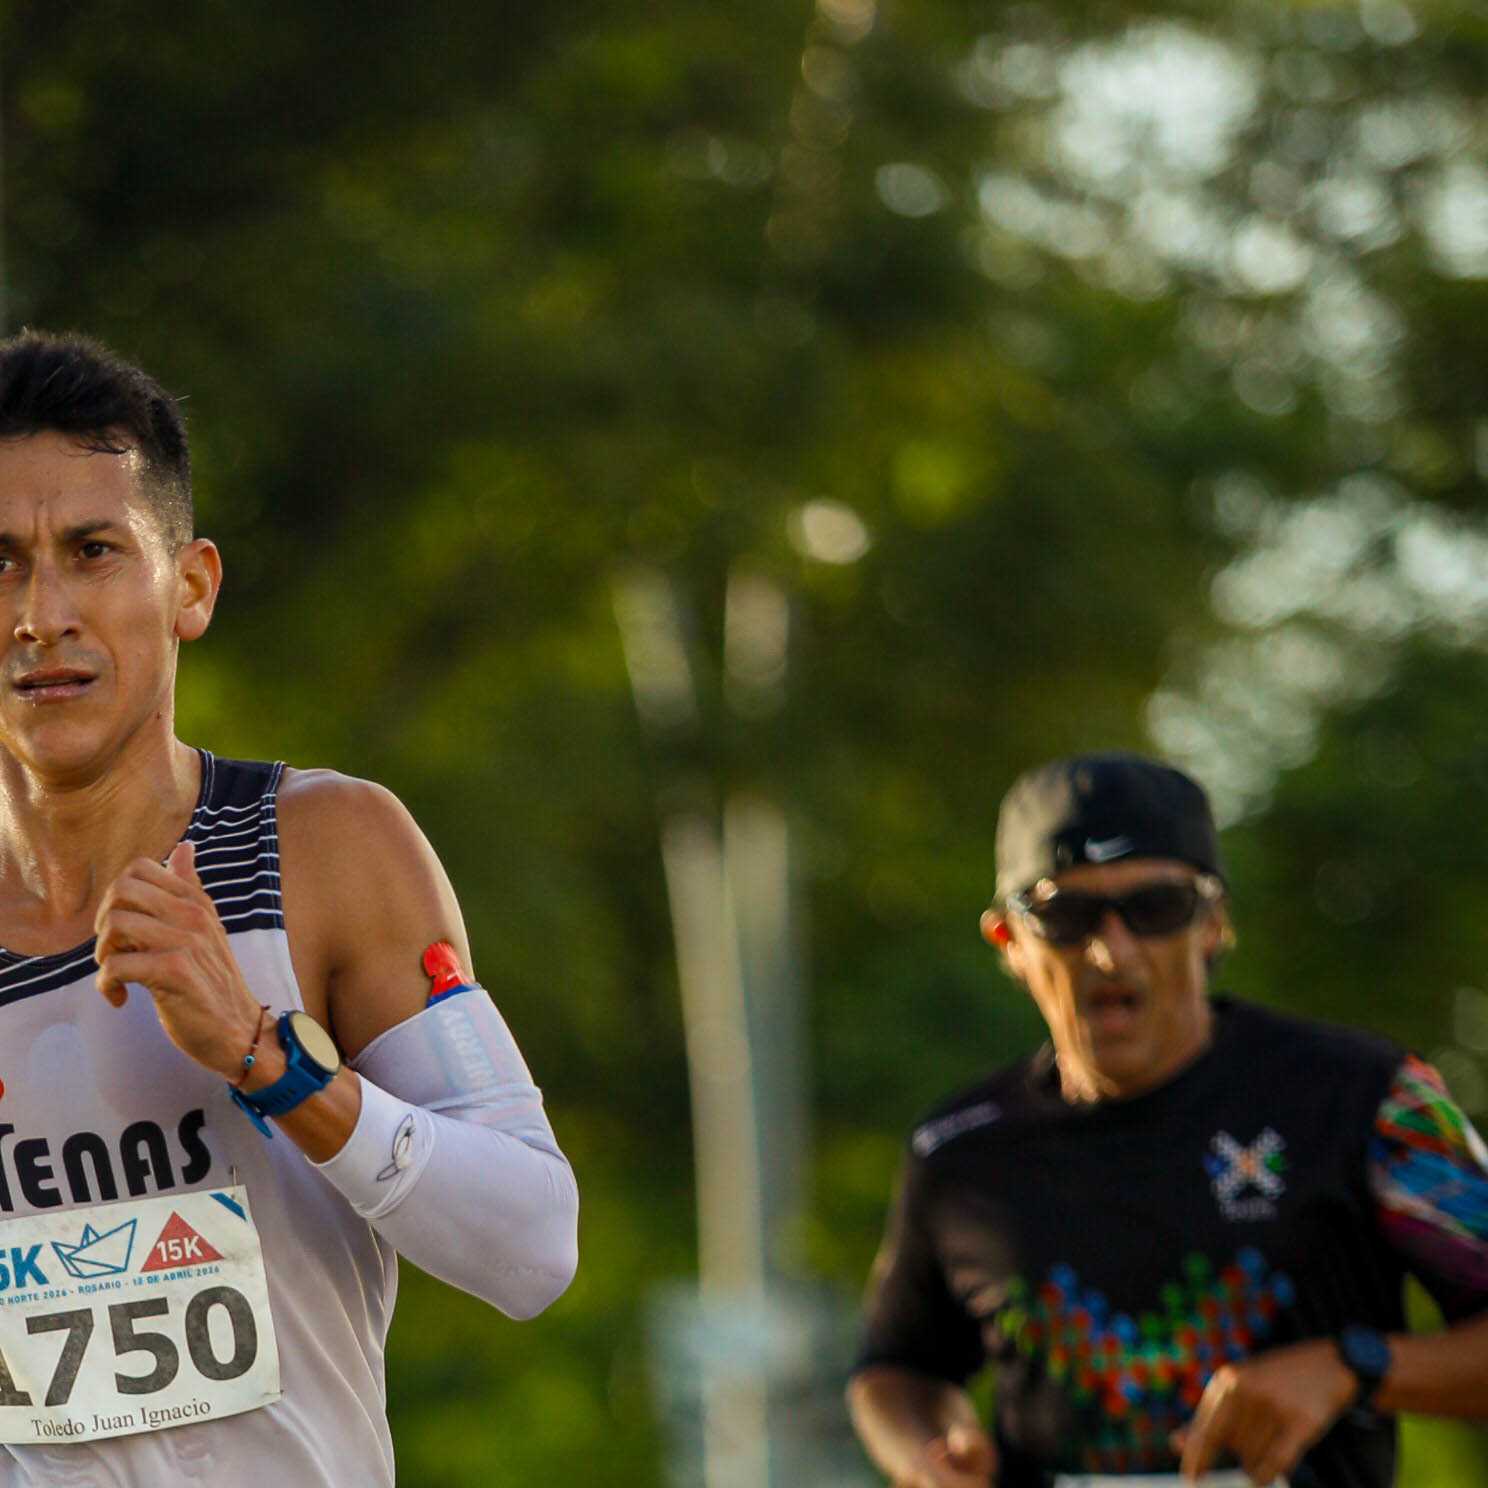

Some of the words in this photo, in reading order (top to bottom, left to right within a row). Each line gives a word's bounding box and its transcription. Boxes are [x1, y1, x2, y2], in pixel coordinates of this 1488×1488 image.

[157, 1235, 203, 1263] 15K
[8, 1293, 40, 1305] NORTE
[43, 1289, 67, 1300] 2026
[77, 1280, 121, 1295] ROSARIO
[146, 1275, 160, 1285] DE
[163, 1270, 193, 1282] ABRIL
[196, 1265, 220, 1277] 2026
[31, 1417, 86, 1437] Toledo
[92, 1412, 135, 1433] Juan
[140, 1397, 212, 1429] Ignacio
